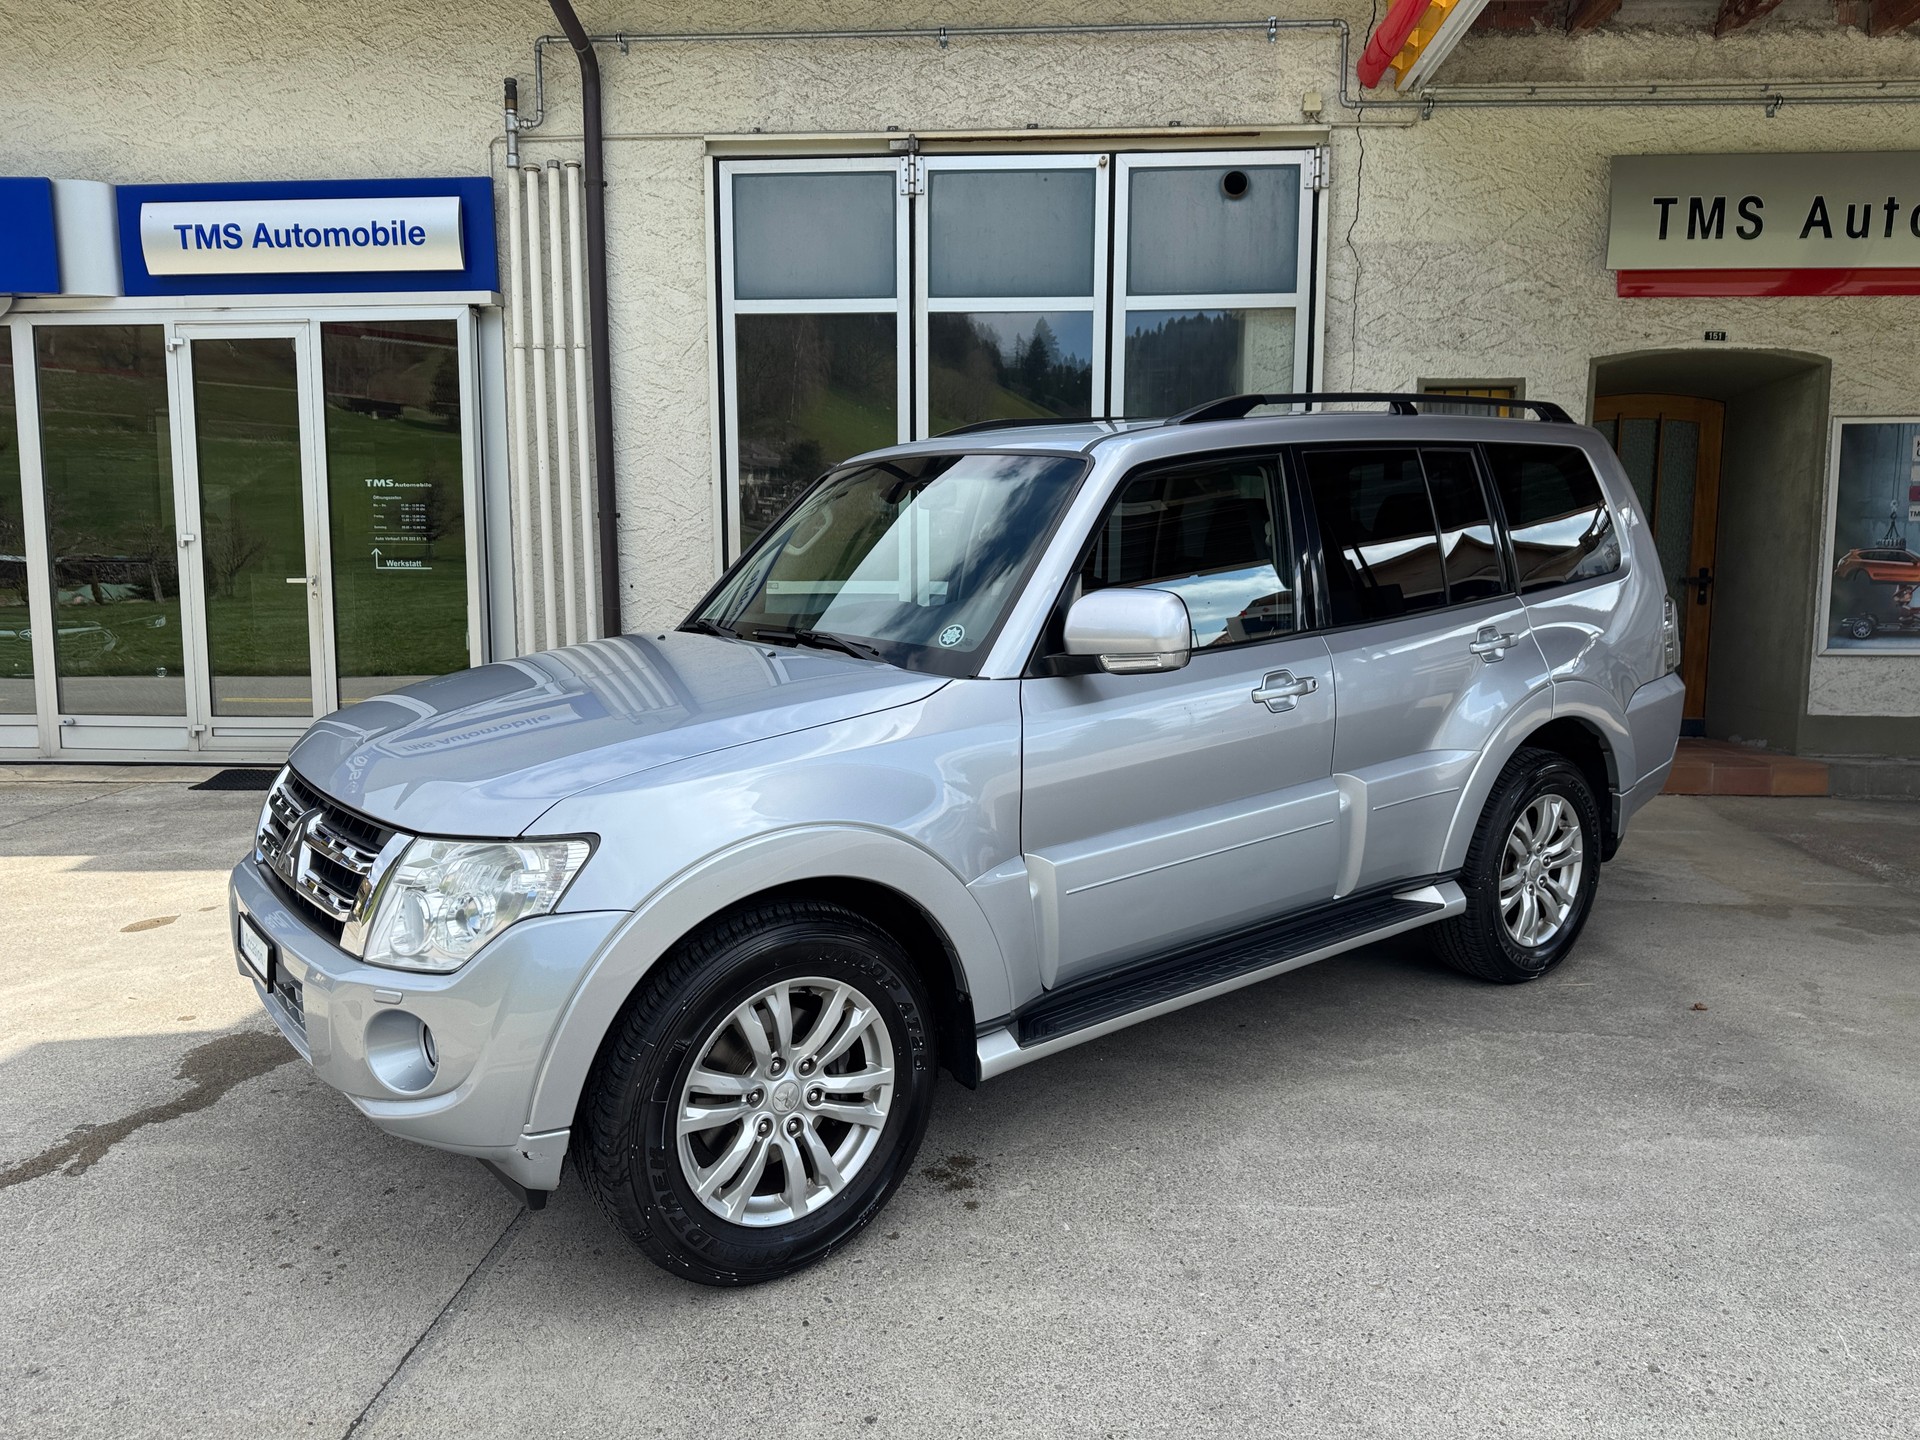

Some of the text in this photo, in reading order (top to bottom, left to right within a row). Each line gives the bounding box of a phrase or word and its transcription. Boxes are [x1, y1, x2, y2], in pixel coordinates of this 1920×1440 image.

[1652, 195, 1765, 240] TMS
[173, 219, 427, 250] TMS Automobile
[1707, 332, 1723, 341] 151
[365, 479, 394, 487] TMS
